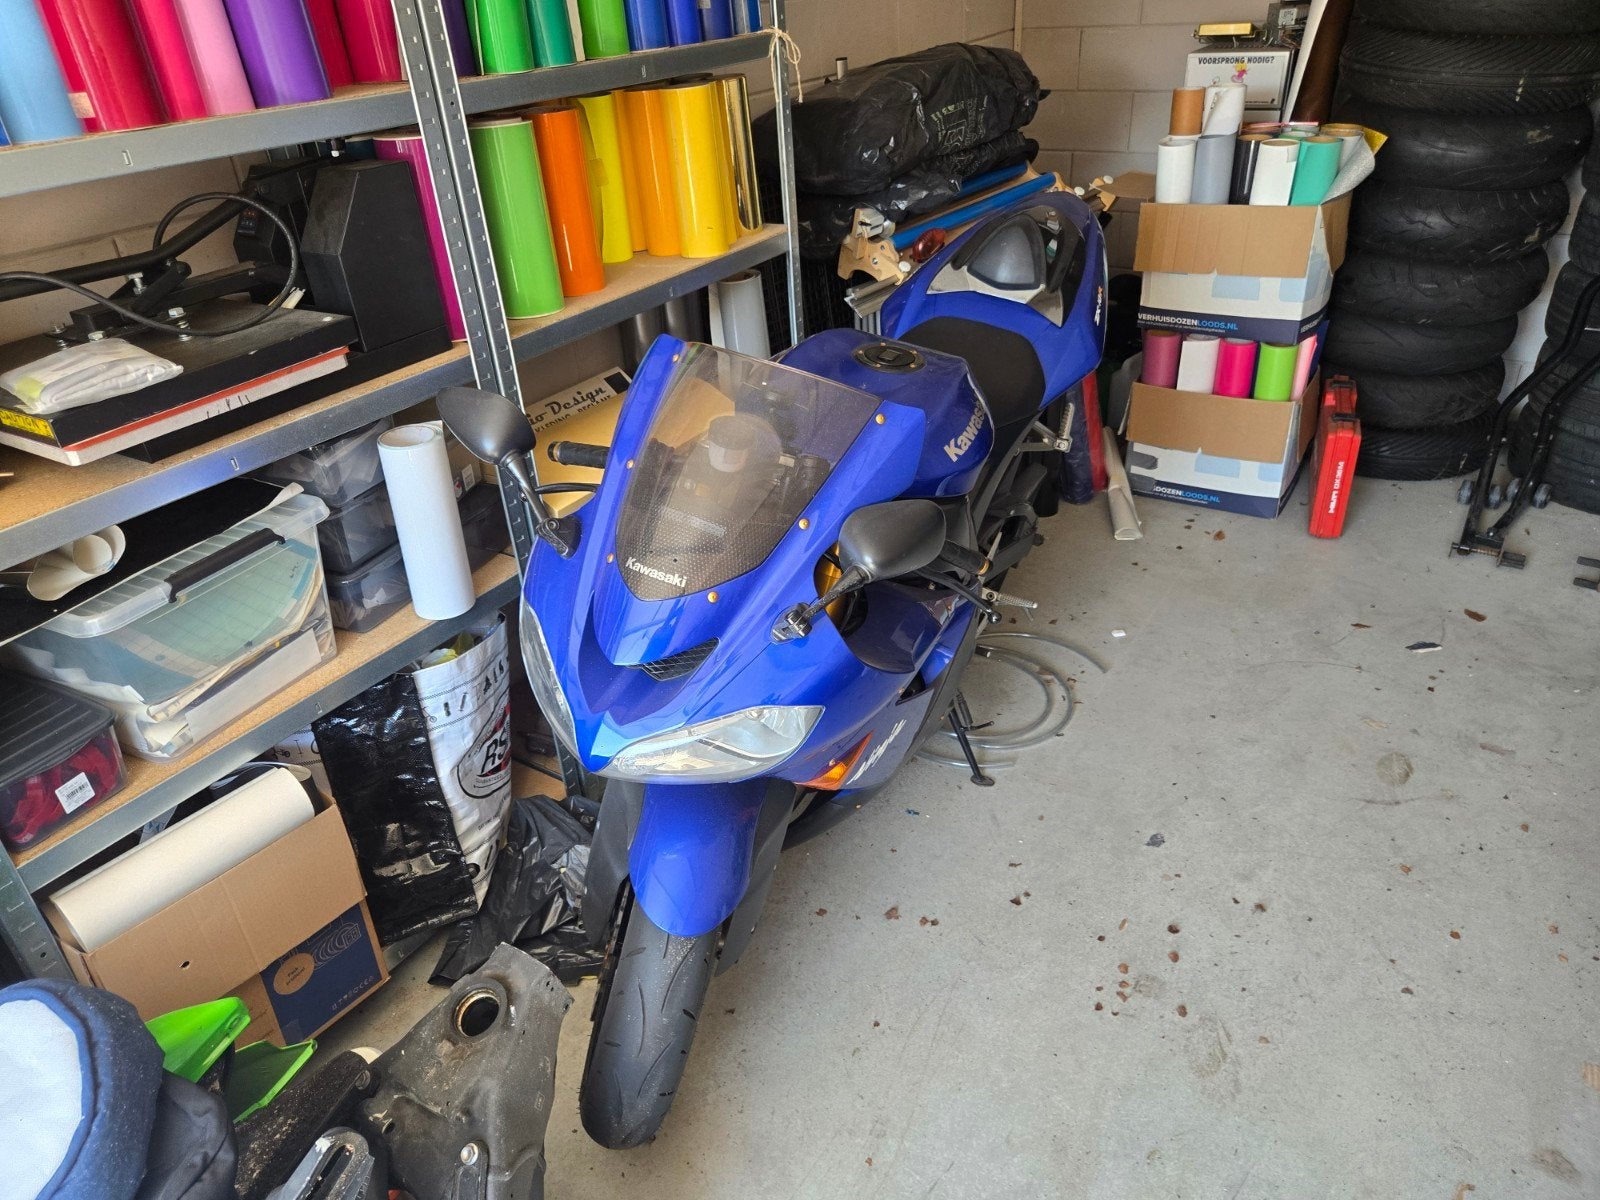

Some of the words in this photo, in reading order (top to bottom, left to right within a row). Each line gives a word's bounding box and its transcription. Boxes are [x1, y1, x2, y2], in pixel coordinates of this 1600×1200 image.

[1198, 57, 1245, 65] VOORSPRONG
[1246, 56, 1275, 64] NODIG?
[1138, 313, 1238, 330] VERHUISDOZENLOODS.NL
[545, 387, 606, 416] Design
[625, 557, 688, 587] Kawasaki
